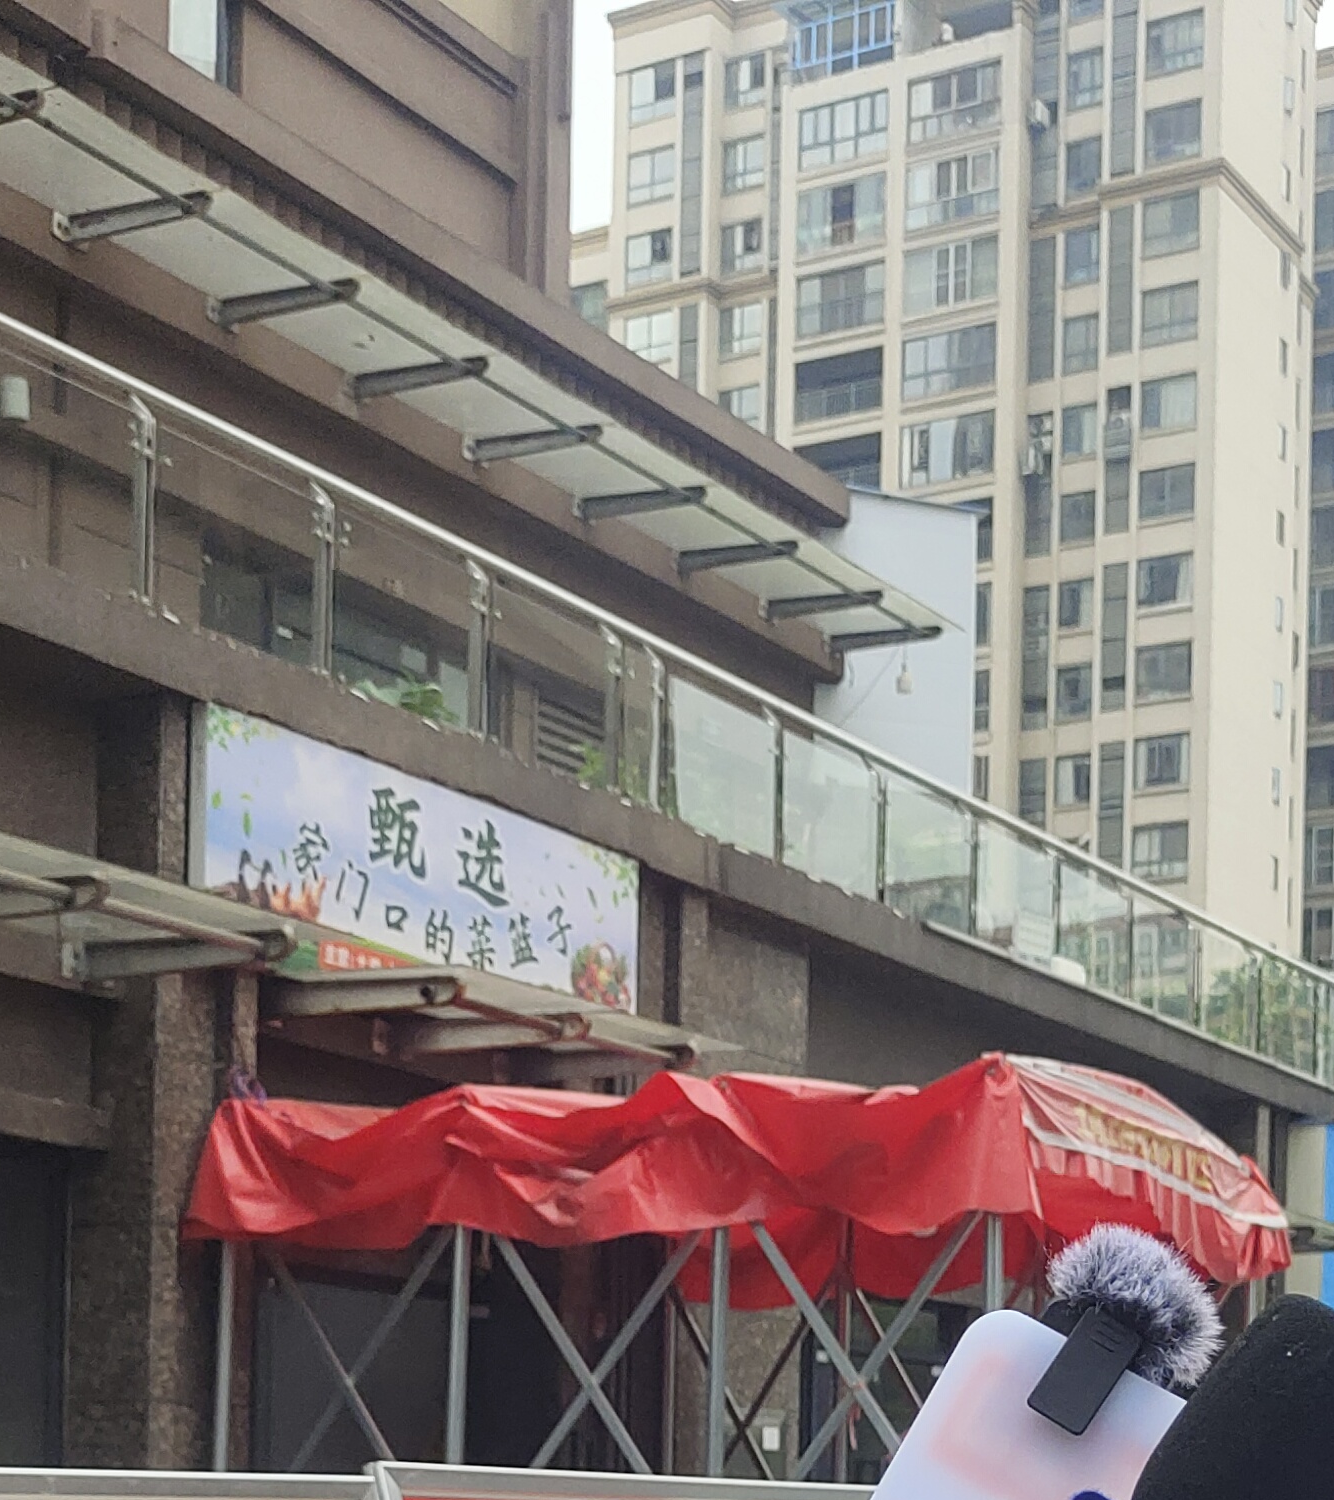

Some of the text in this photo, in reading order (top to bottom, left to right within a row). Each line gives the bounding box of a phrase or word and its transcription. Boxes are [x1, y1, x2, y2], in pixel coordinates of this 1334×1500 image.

[294, 822, 572, 972] 家门口的菜篮子
[367, 787, 509, 907] 甄选
